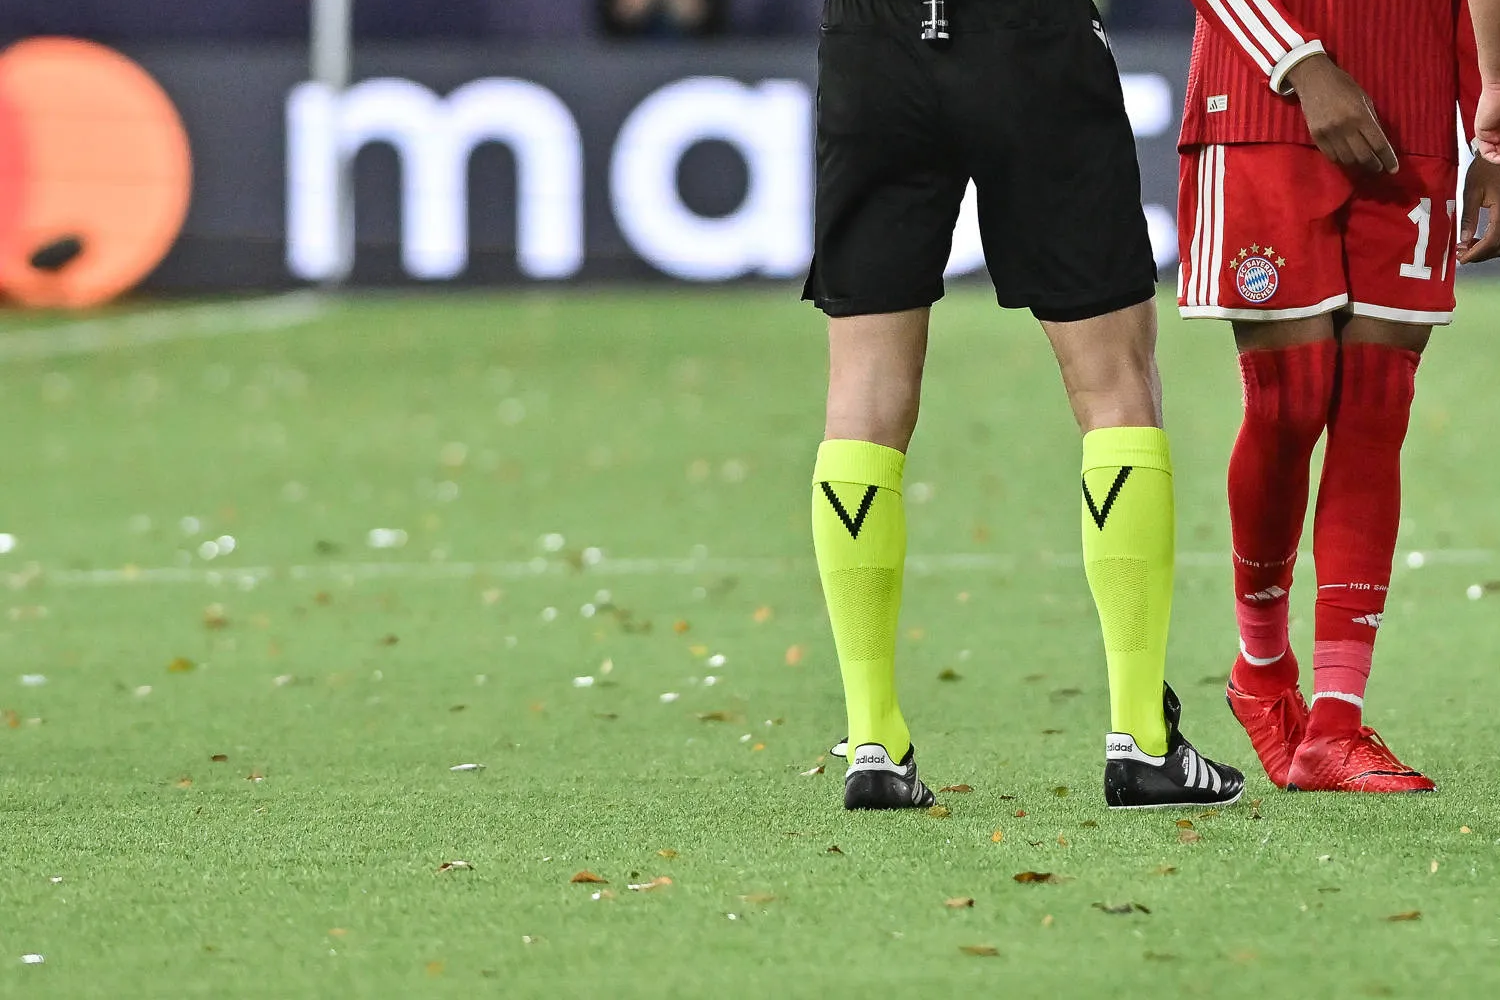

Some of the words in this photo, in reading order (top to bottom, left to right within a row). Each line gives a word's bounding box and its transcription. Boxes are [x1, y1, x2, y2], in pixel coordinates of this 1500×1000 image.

[1246, 259, 1274, 276] BAYERN
[1350, 582, 1370, 591] MIA
[855, 754, 885, 765] adidas
